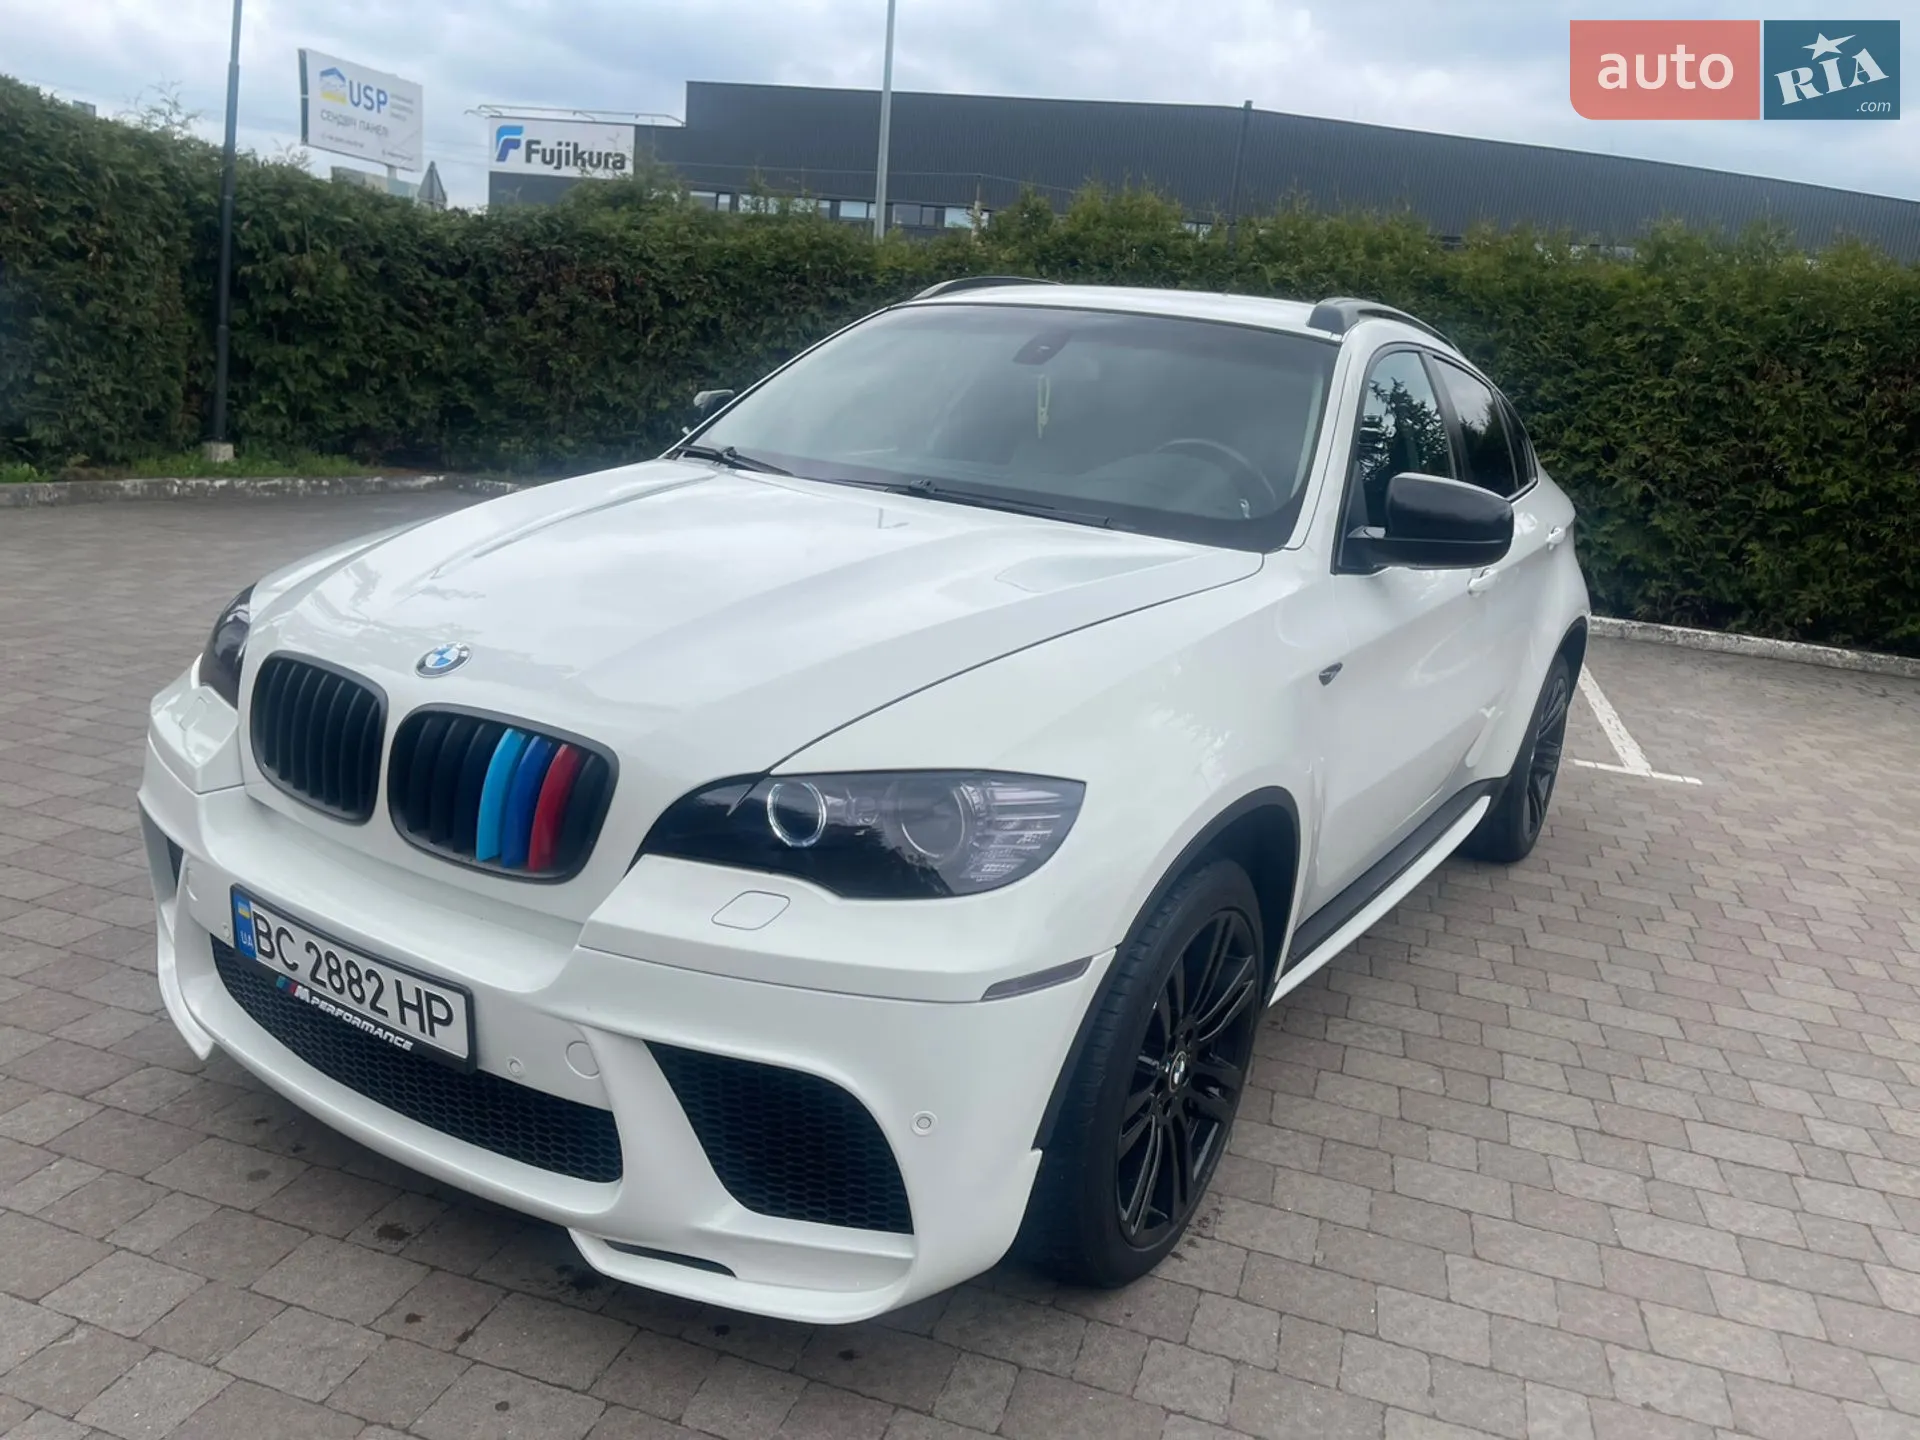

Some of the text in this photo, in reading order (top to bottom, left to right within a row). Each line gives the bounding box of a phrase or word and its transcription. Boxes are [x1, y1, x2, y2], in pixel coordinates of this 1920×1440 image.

[349, 79, 388, 114] USP
[525, 139, 626, 171] Fujikura
[252, 910, 455, 1038] BC 2882 HP
[310, 995, 414, 1052] PERFORMANCE
